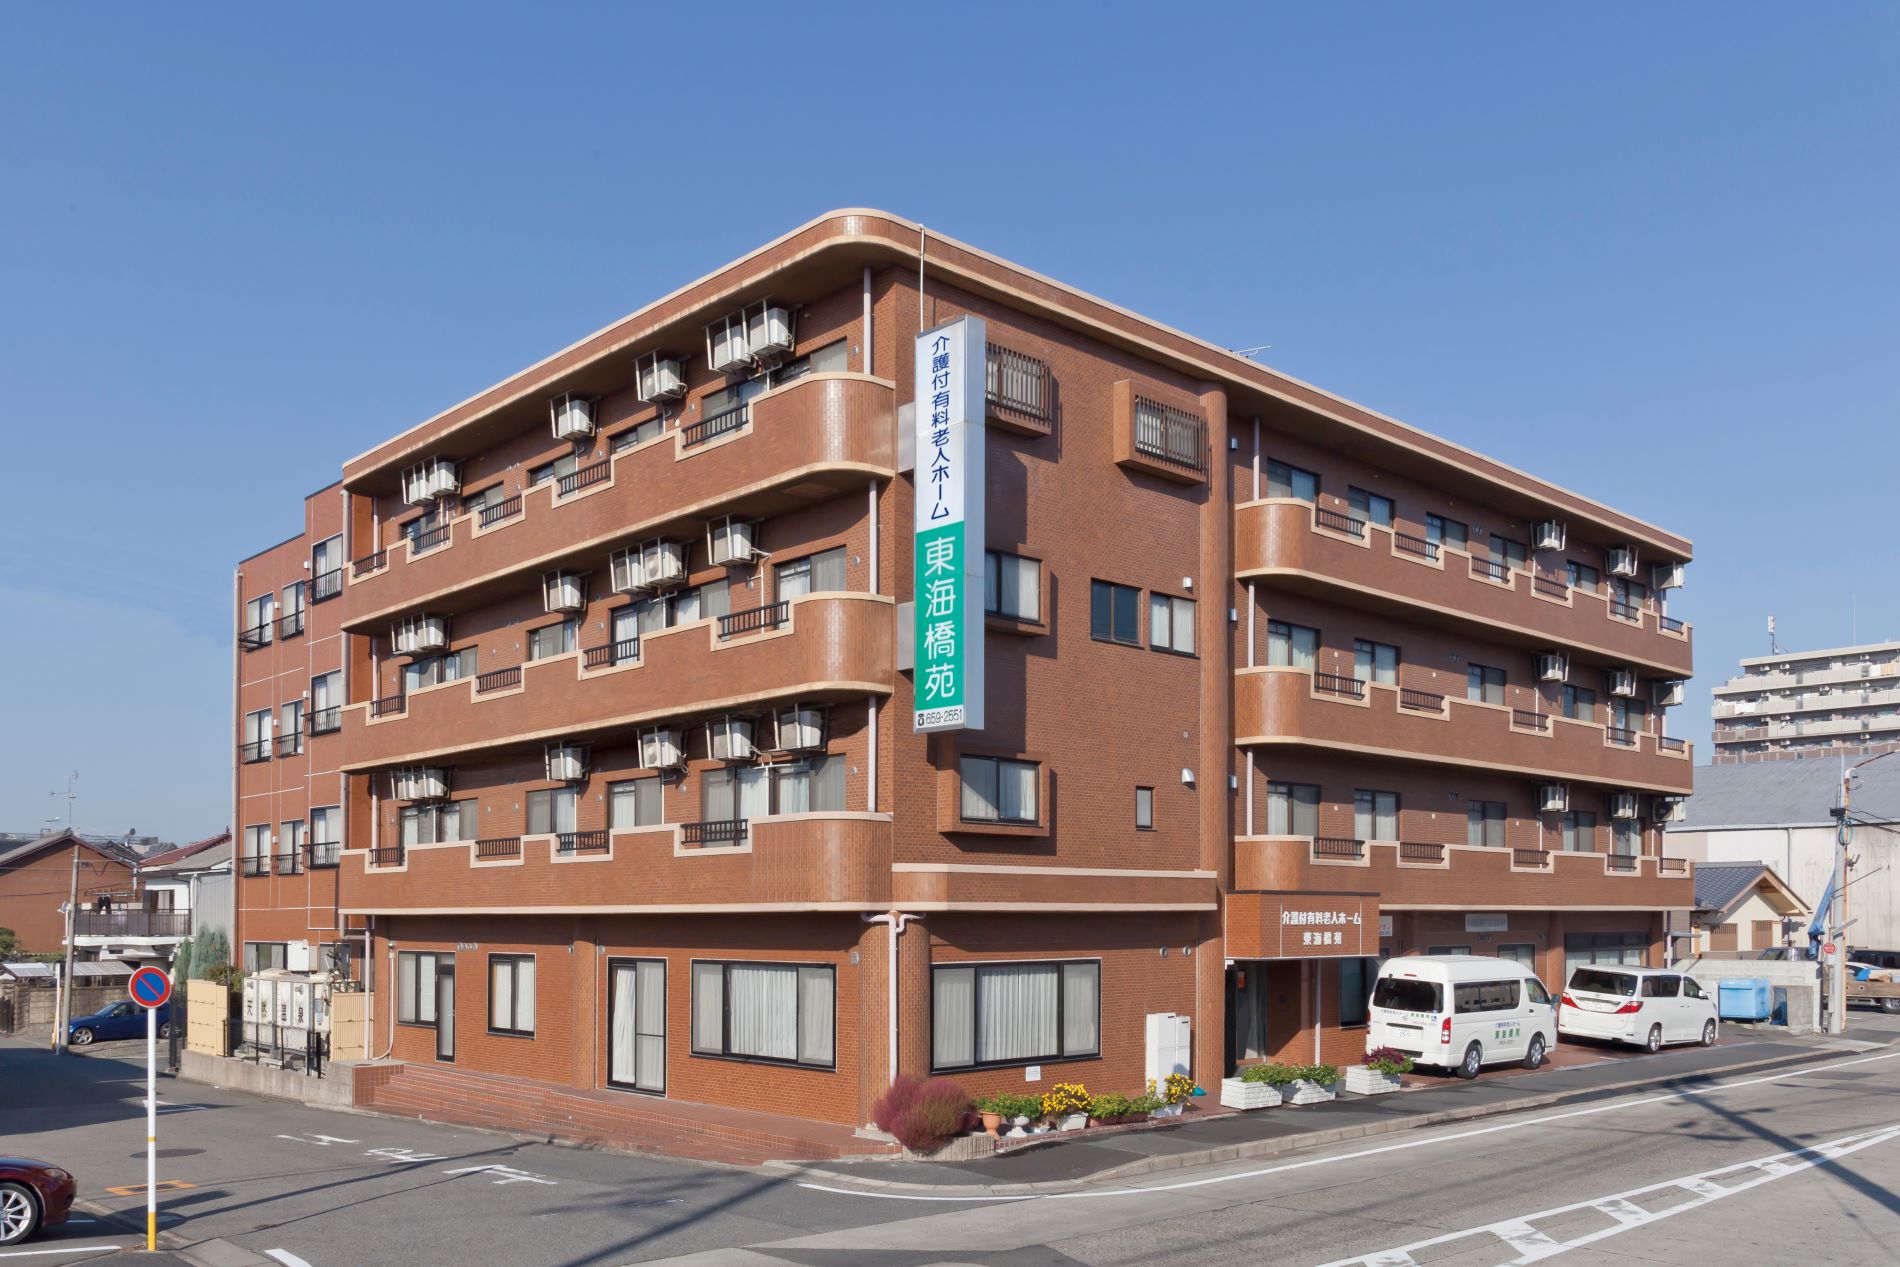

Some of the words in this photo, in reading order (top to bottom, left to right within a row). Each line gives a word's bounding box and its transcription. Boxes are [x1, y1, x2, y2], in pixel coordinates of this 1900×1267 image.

[931, 335, 951, 520] 介護付有料老人ホーム
[923, 536, 956, 701] 東海橋苑
[925, 709, 962, 725] 659-2551
